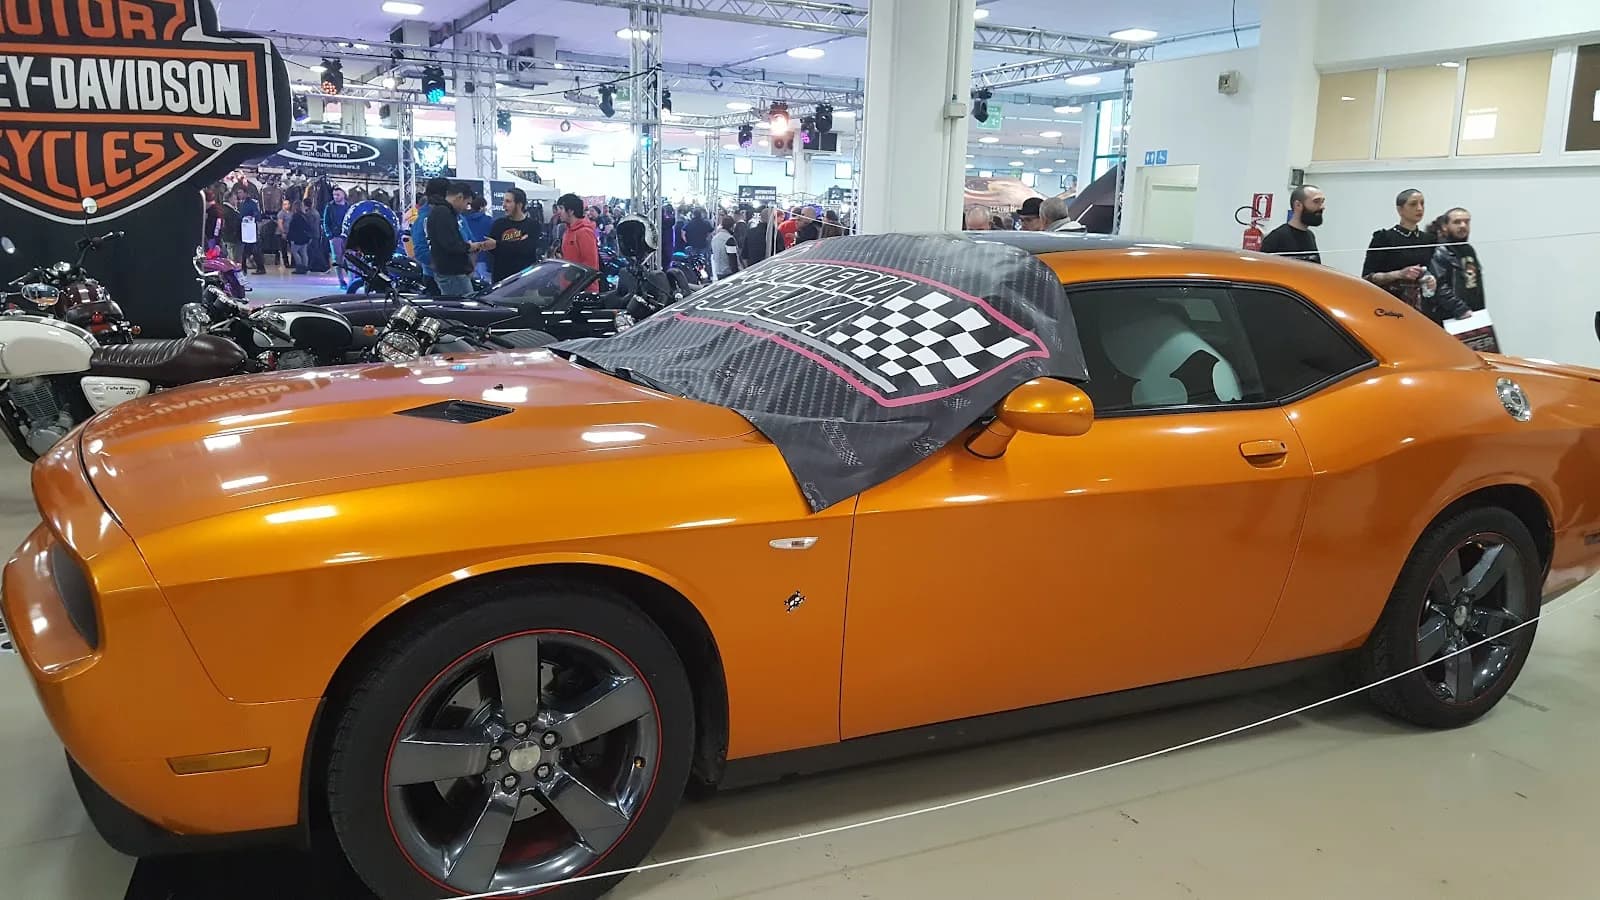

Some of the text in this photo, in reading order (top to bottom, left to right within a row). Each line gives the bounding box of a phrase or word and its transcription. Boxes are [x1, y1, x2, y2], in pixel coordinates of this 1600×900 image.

[0, 0, 158, 41] OTOR
[0, 129, 165, 198] YCLES
[741, 261, 917, 307] SCUDERIA
